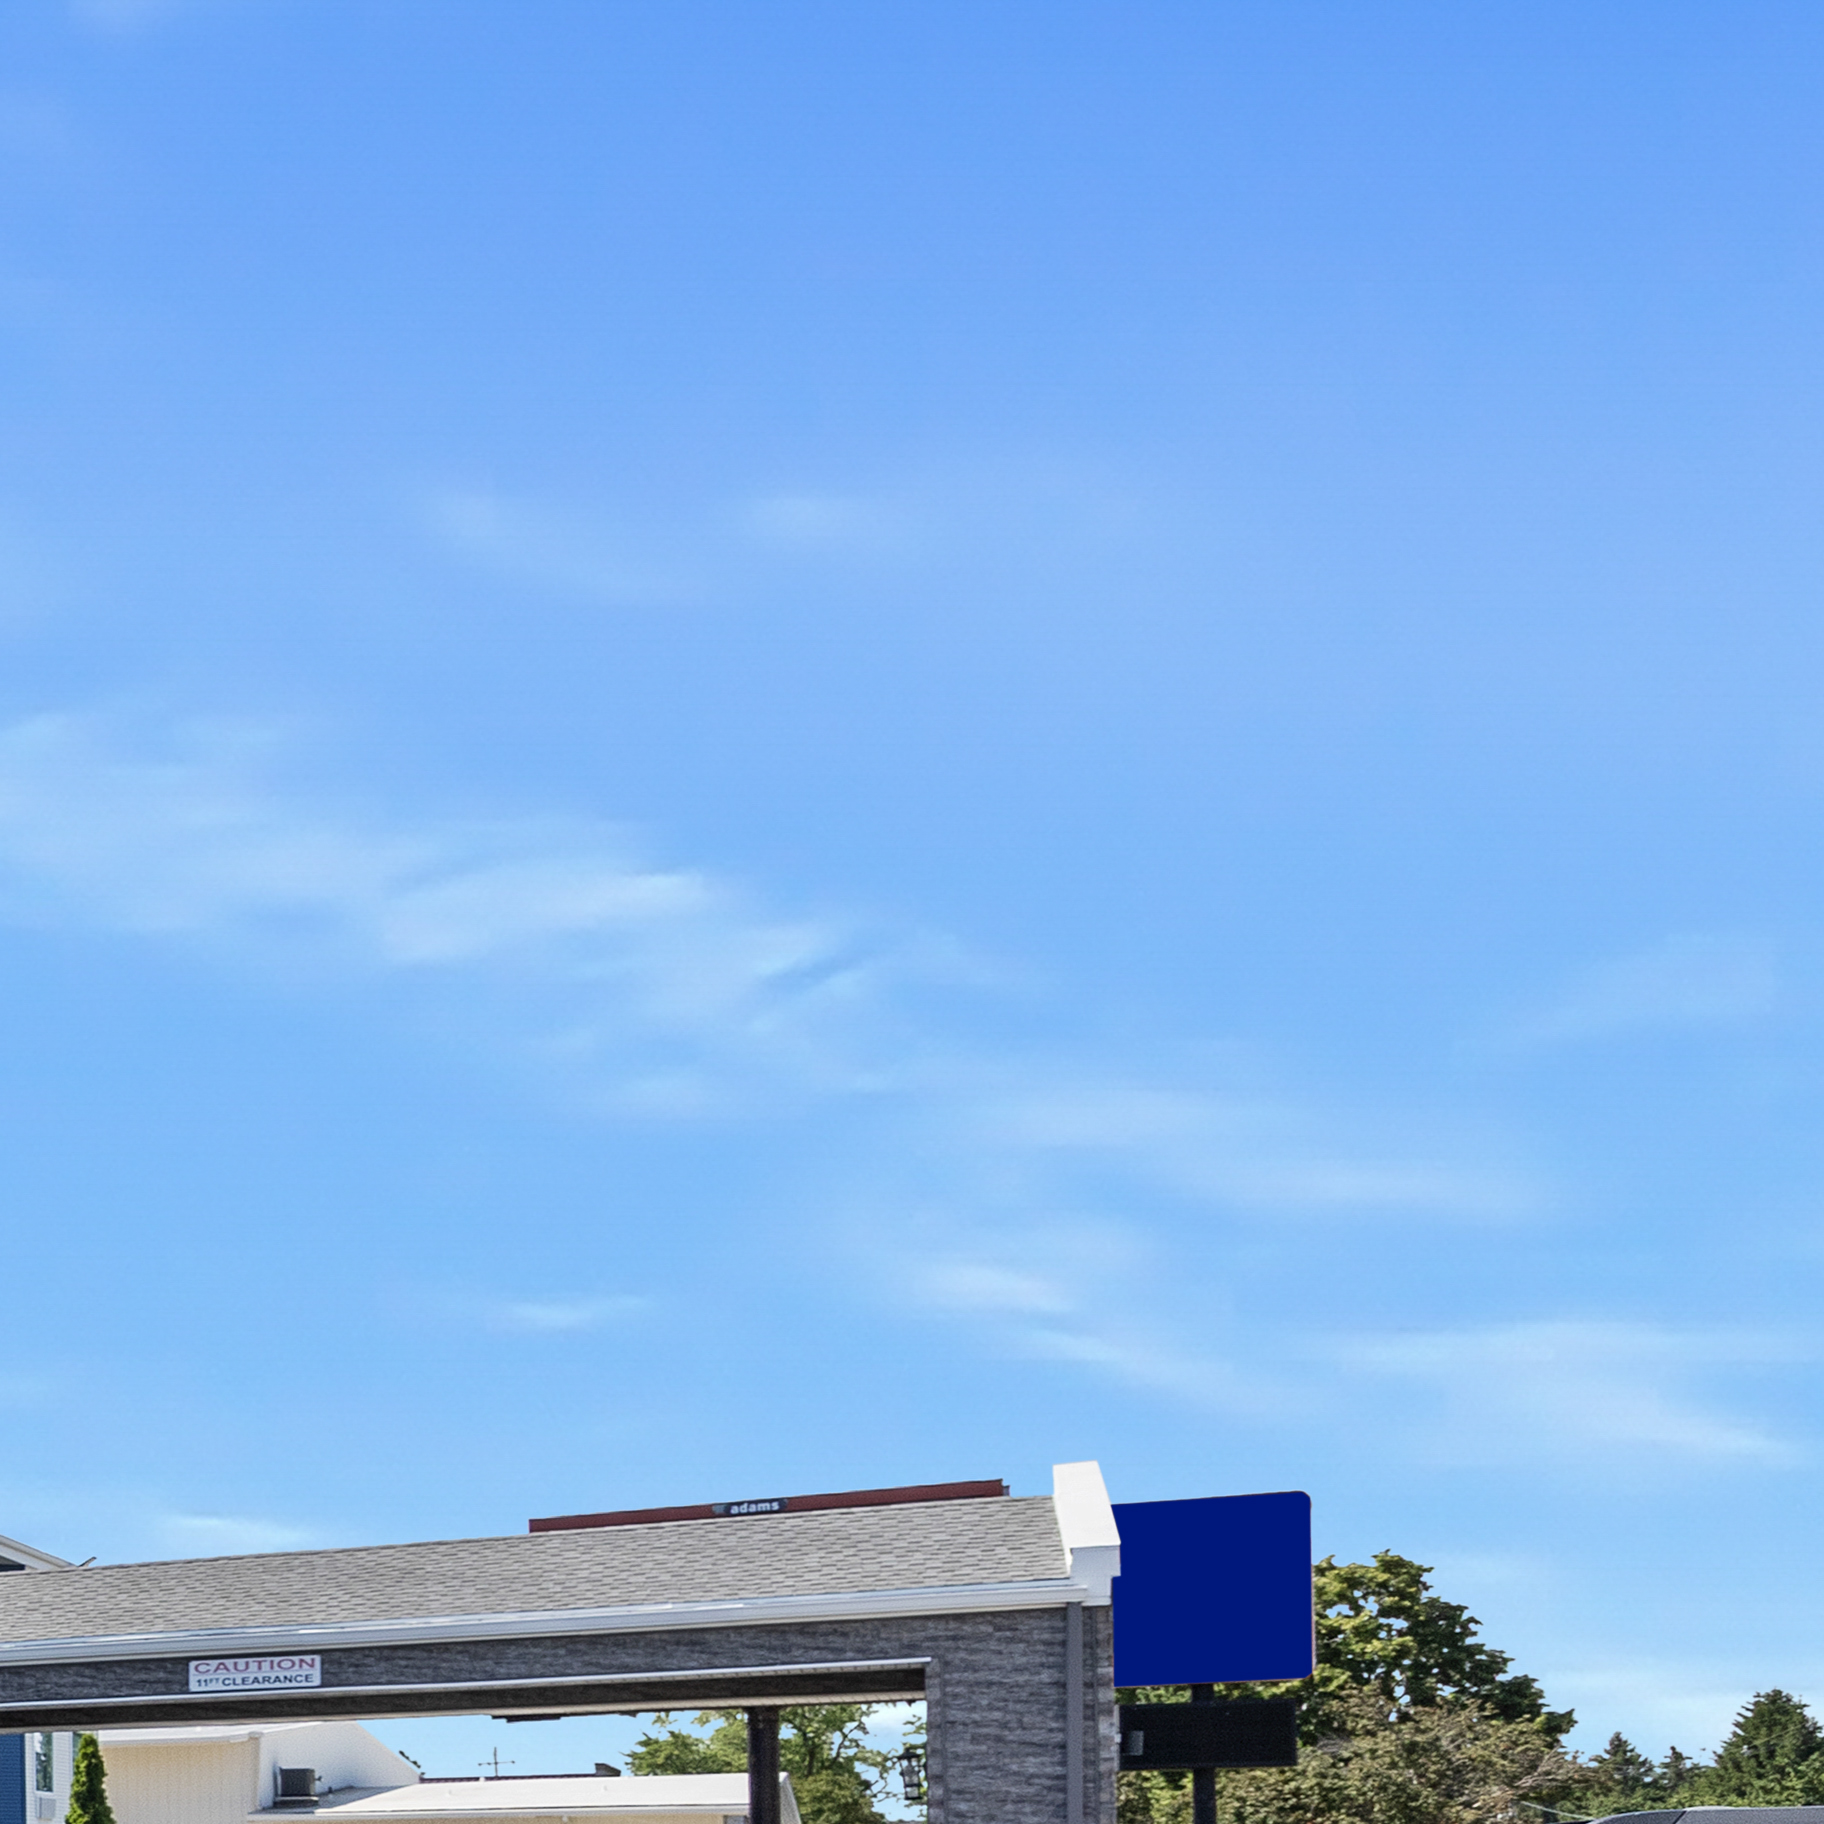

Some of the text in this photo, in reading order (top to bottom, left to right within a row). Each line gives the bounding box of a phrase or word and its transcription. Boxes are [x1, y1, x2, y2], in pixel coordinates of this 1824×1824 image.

[730, 1501, 780, 1514] adams
[194, 1658, 316, 1675] CAUTION
[221, 1674, 314, 1687] CLEARANCE
